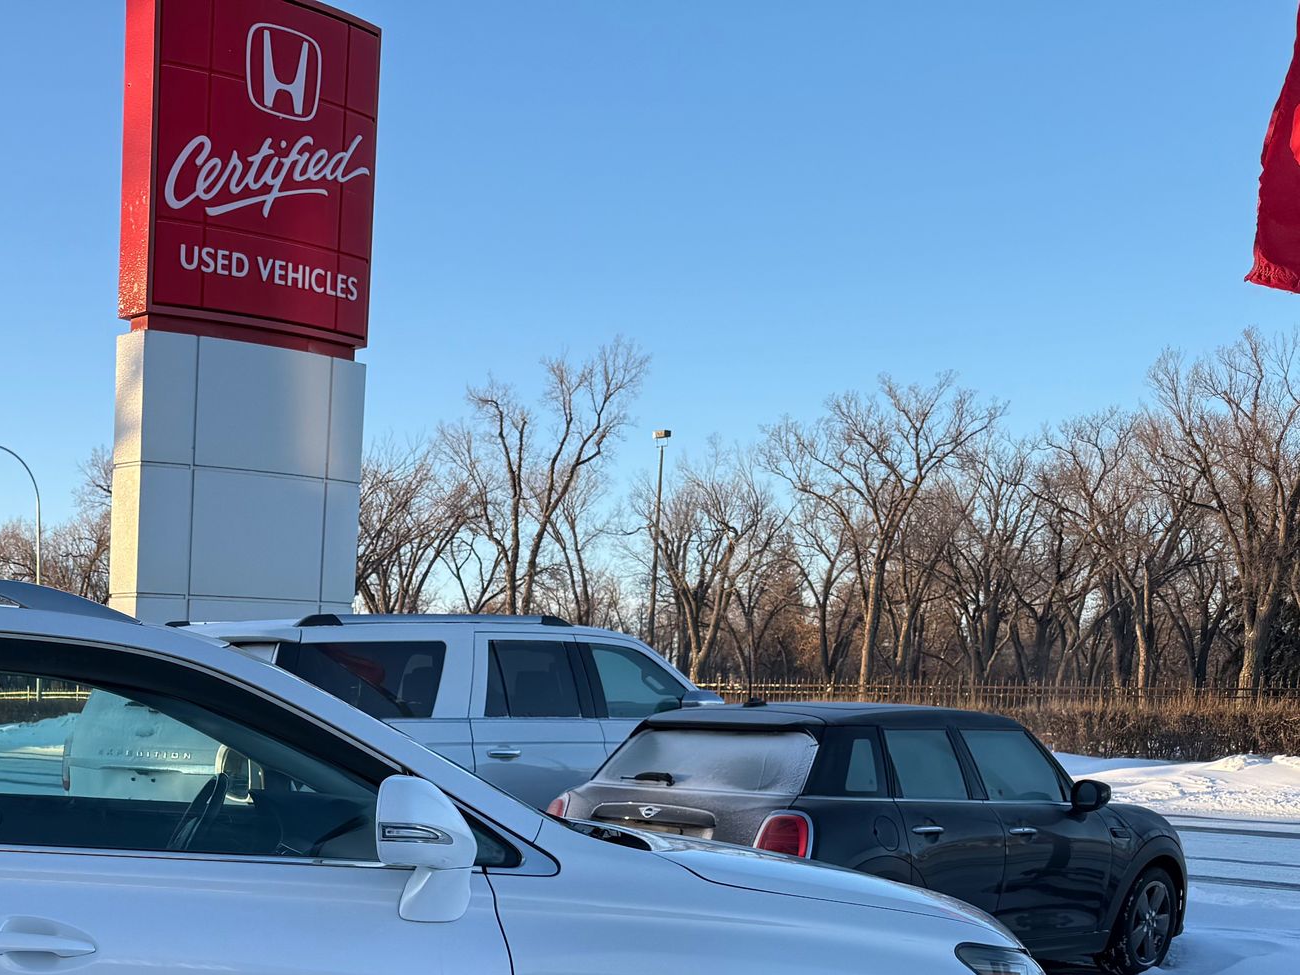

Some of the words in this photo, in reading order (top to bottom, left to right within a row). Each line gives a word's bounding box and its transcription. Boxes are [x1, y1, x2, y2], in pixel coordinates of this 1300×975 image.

[164, 134, 370, 218] Certified
[179, 244, 250, 278] USED
[256, 256, 358, 301] VEHICLES
